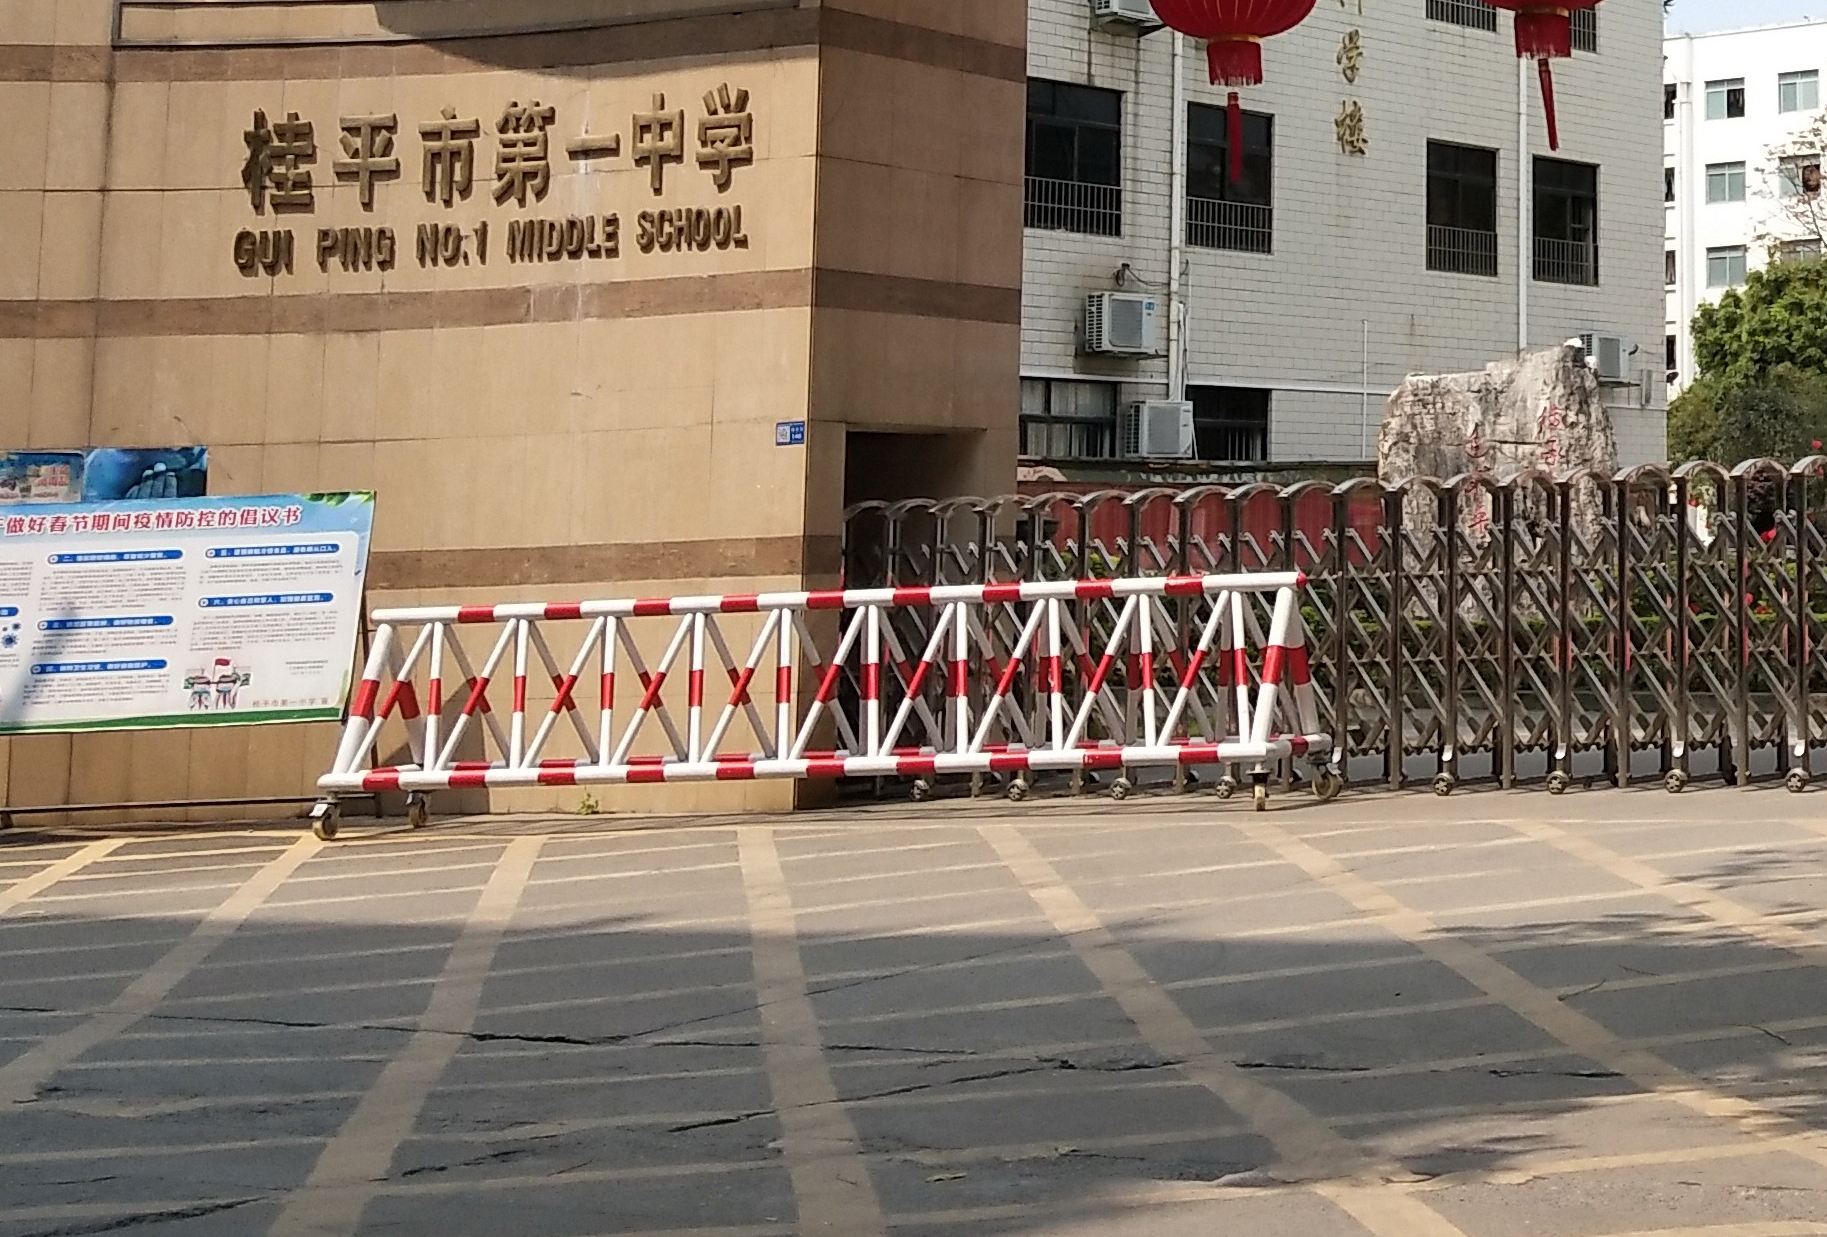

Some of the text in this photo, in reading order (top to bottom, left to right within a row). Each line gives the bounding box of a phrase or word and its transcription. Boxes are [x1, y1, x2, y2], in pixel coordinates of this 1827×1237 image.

[242, 82, 753, 214] 桂平市第一中学
[233, 226, 294, 277] GUI
[317, 227, 395, 271] PING
[506, 212, 620, 263] MIDDLE
[636, 205, 749, 254] SCHOOL
